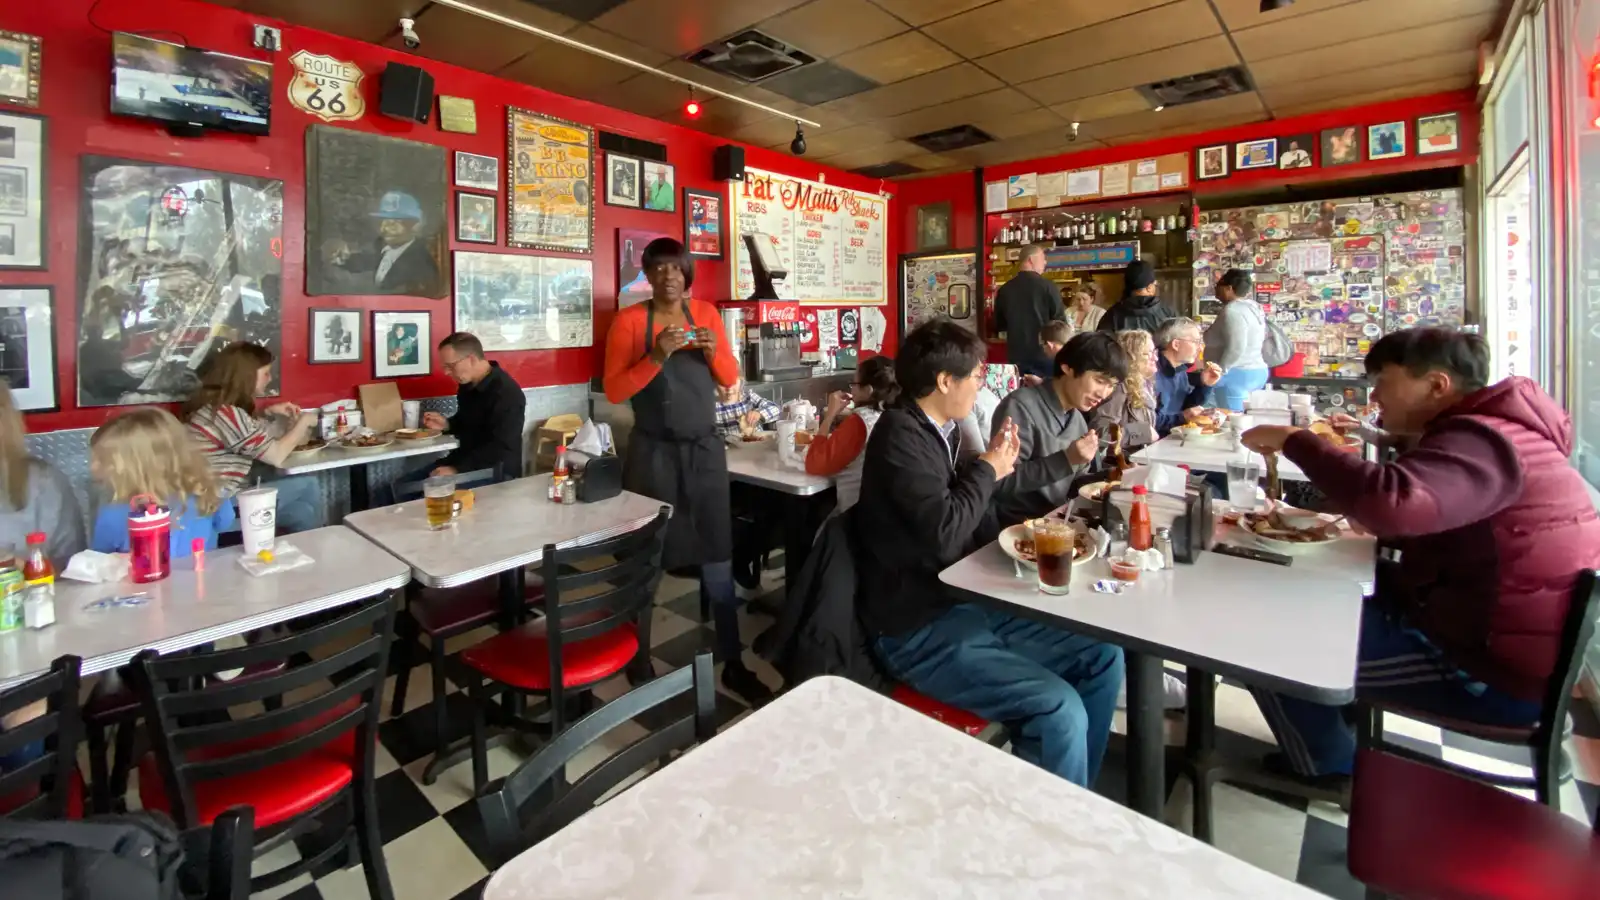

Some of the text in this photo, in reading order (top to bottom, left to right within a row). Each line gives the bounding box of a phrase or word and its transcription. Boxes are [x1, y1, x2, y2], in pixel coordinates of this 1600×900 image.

[303, 57, 351, 78] ROUTE
[314, 77, 340, 90] US
[306, 88, 346, 115] 66
[532, 162, 588, 179] KING
[741, 171, 839, 213] Fat Matts
[747, 201, 768, 214] RIBS
